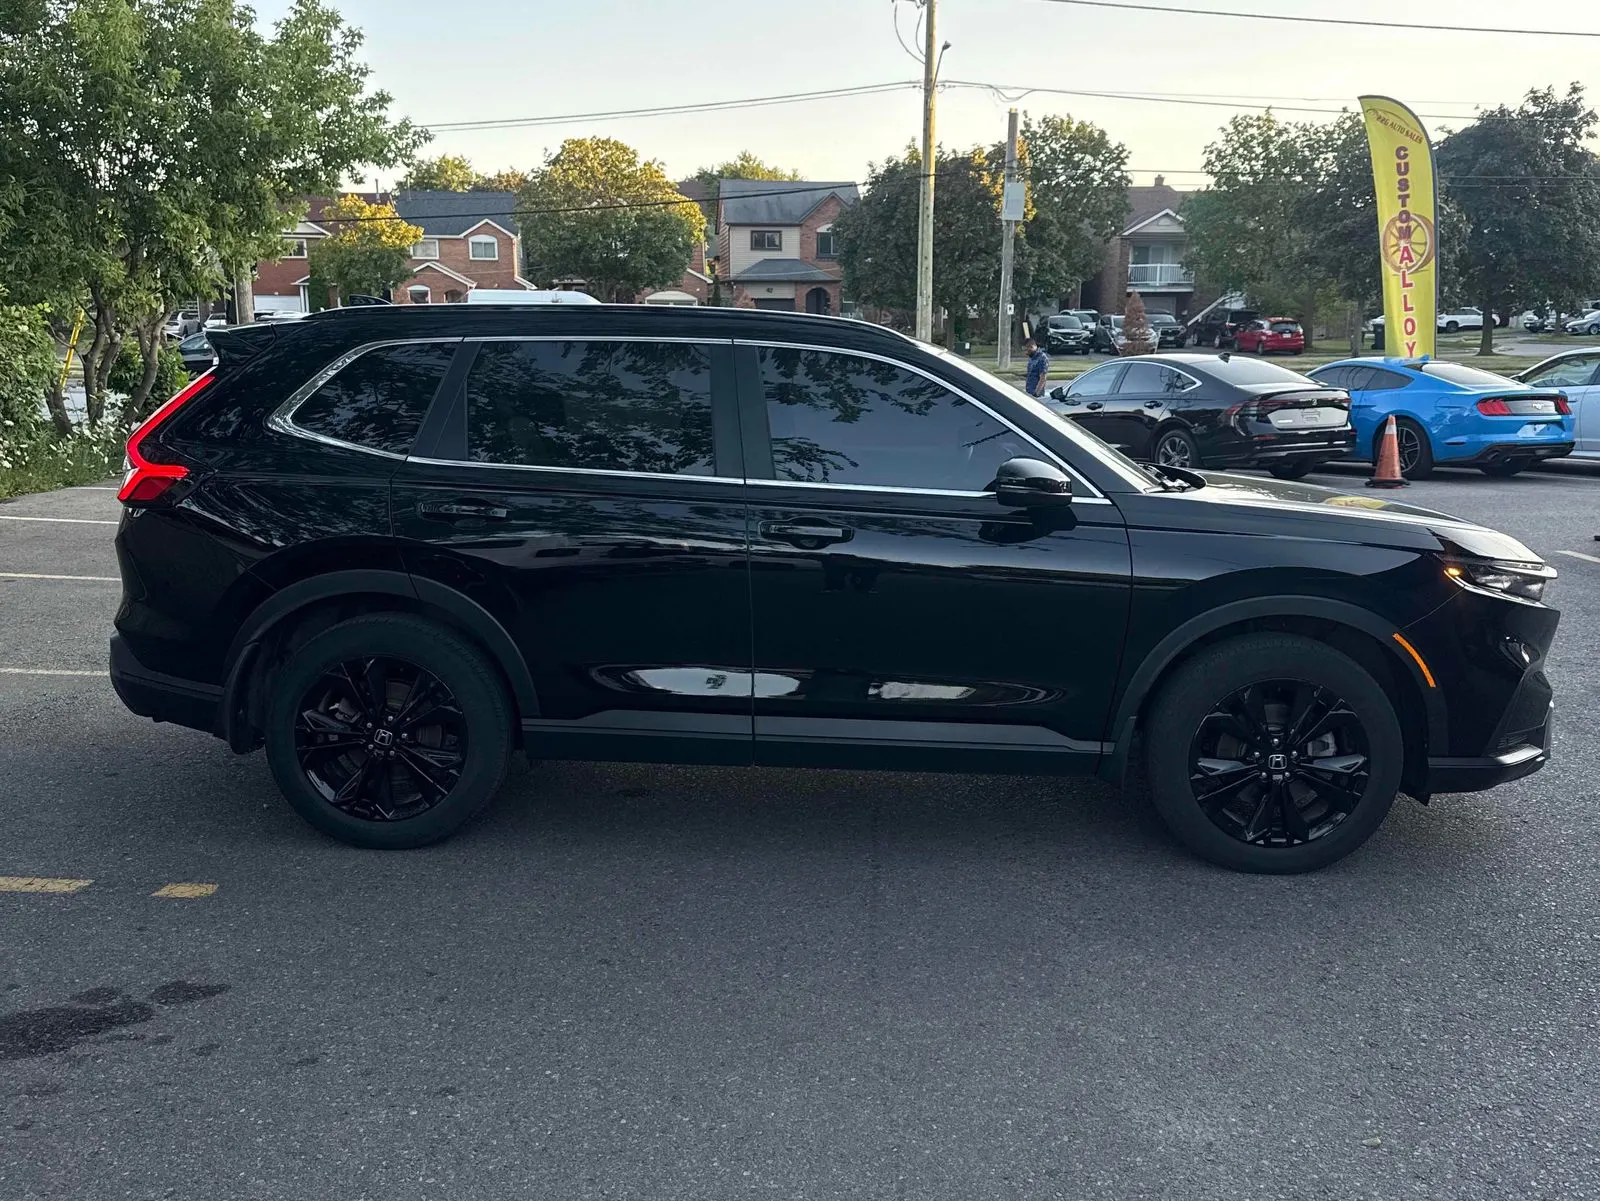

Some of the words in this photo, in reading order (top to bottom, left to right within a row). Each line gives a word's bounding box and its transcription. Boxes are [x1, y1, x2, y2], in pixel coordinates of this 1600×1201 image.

[1389, 122, 1406, 134] AUTO
[1404, 130, 1423, 144] SALES
[1395, 146, 1412, 239] CUSTOM
[1399, 246, 1416, 358] ALLOY
